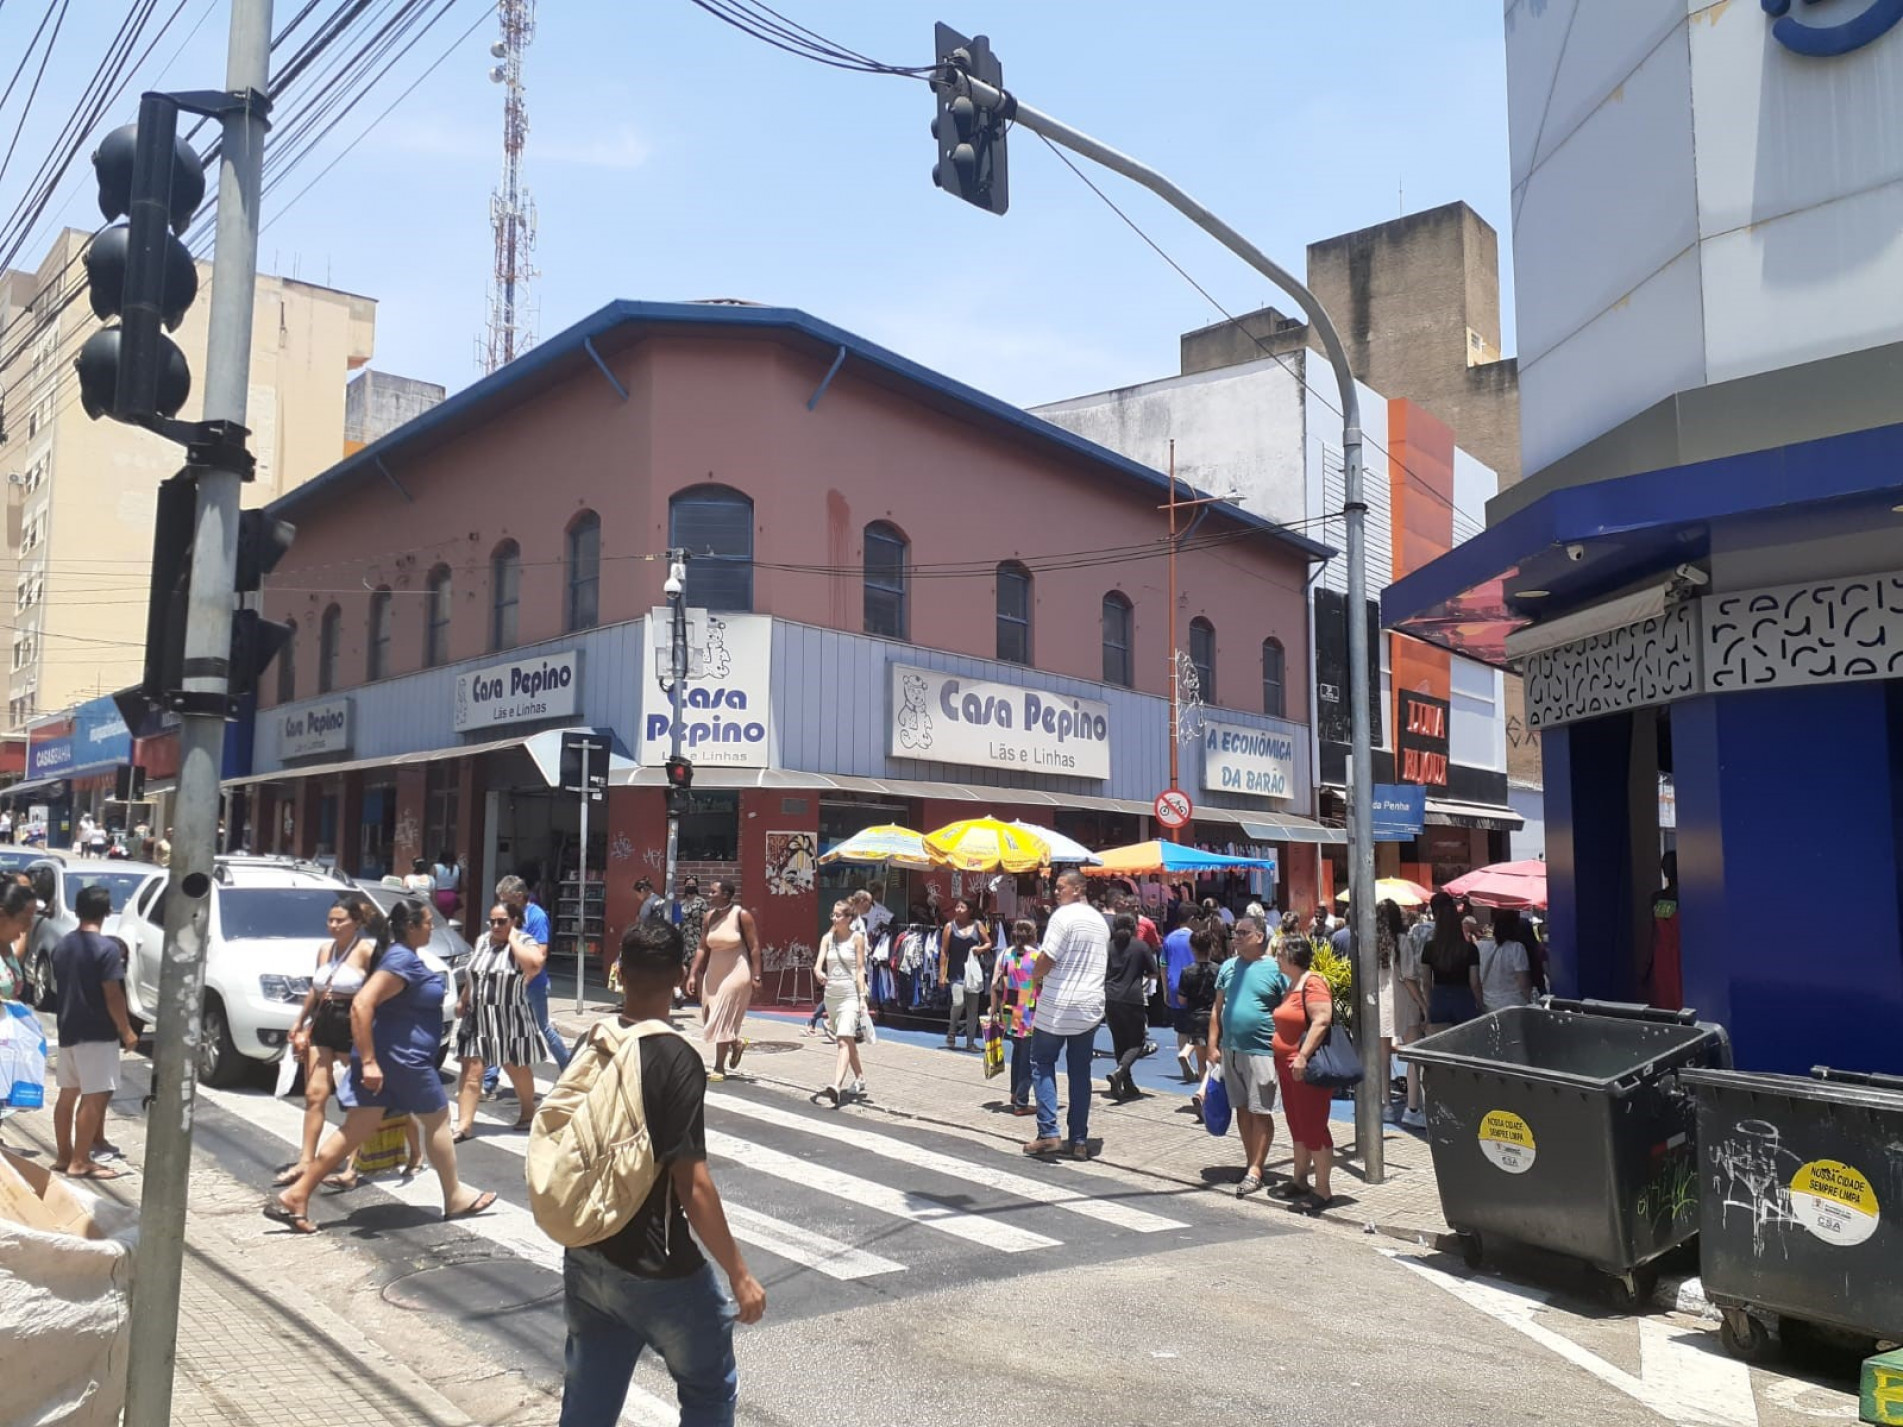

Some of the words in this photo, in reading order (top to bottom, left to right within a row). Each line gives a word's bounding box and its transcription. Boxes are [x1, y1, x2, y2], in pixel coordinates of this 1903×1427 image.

[472, 675, 503, 703] Casa
[510, 661, 572, 698] Pepino
[666, 681, 747, 710] Casa
[307, 708, 344, 736] Pepino
[516, 703, 547, 717] Linhas
[939, 679, 1013, 729] Casa
[1024, 692, 1107, 743] Pepino
[646, 714, 765, 747] Pepino
[1206, 728, 1218, 750] A
[1221, 732, 1292, 761] ECONÔMICA
[702, 751, 748, 761] Linhas
[989, 741, 1016, 761] Lãs
[1019, 749, 1028, 762] e
[1034, 747, 1075, 768] Linhas
[1402, 748, 1447, 786] BIJOUX
[1221, 766, 1241, 789] DA
[1246, 768, 1285, 794] BARÃO
[1383, 800, 1410, 811] Penha
[1809, 1179, 1838, 1197] SEMPRE
[1839, 1190, 1861, 1204] LIMPA
[1810, 1166, 1835, 1182] NOSSA
[1837, 1175, 1866, 1192] CIDADE
